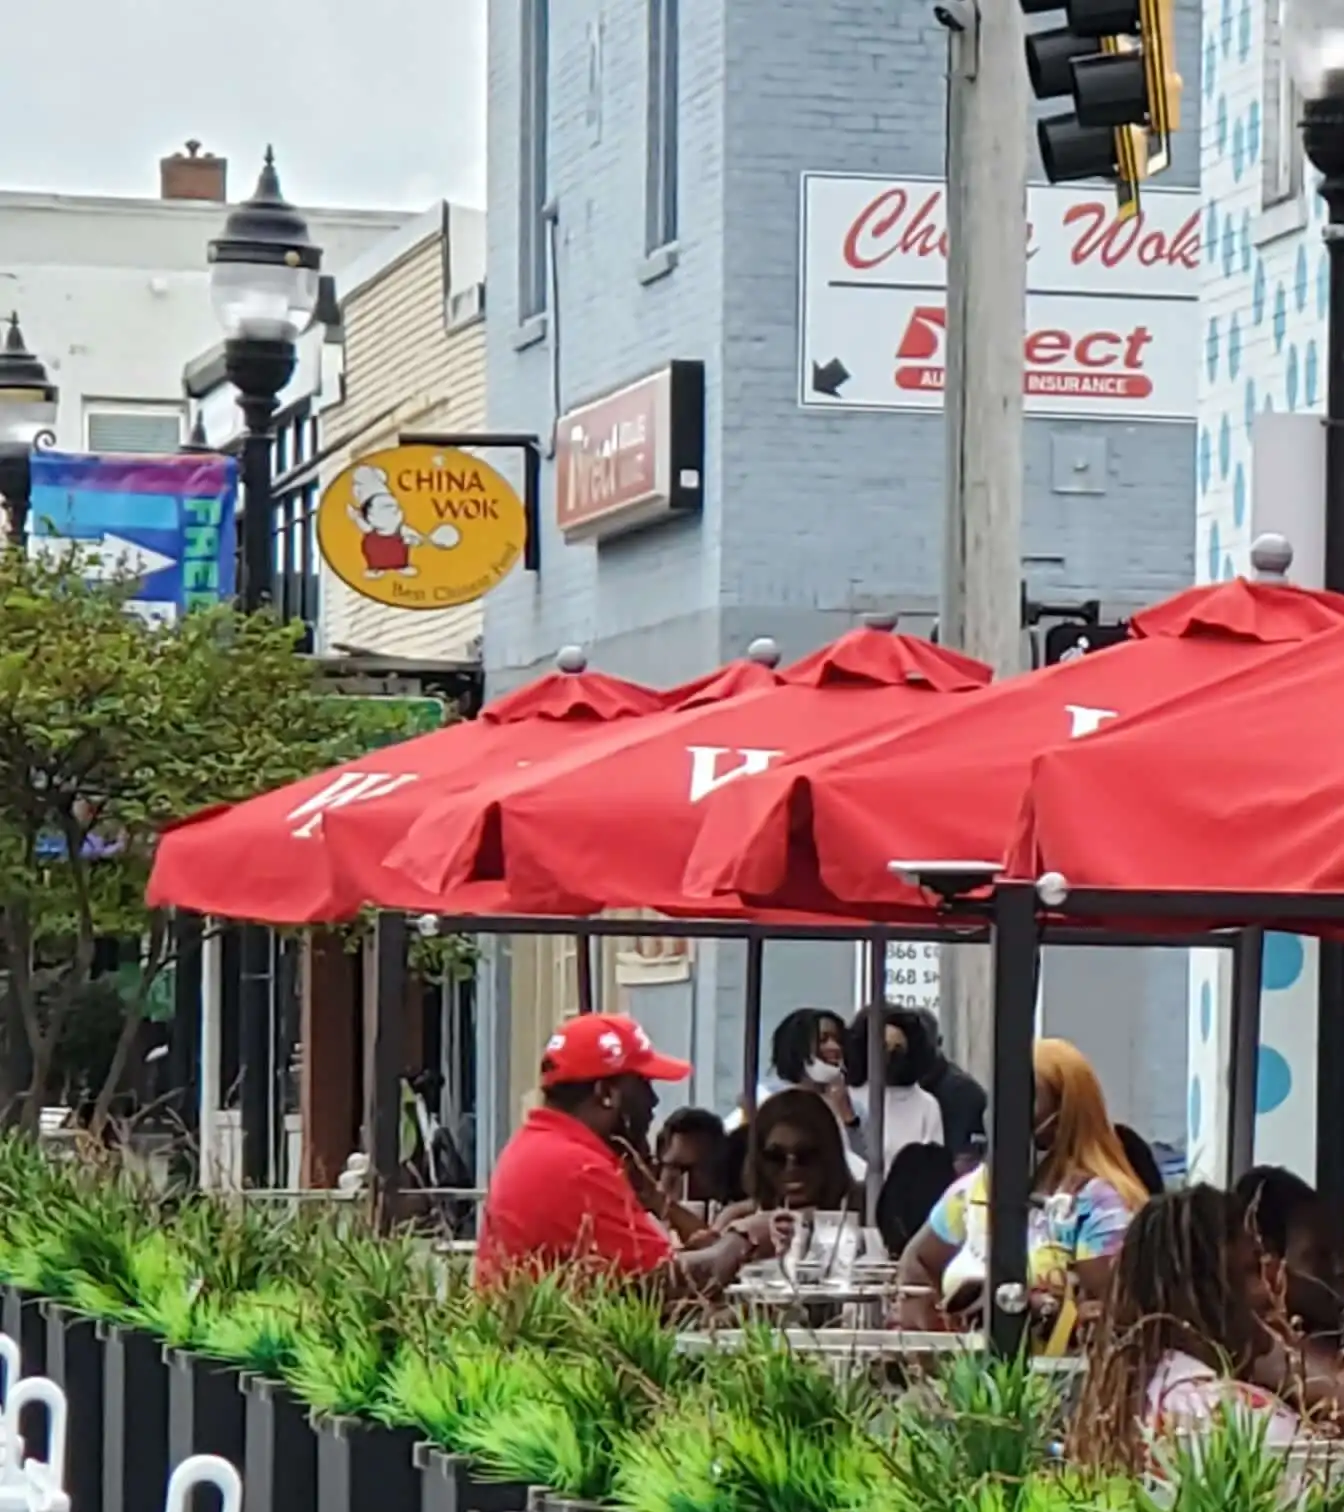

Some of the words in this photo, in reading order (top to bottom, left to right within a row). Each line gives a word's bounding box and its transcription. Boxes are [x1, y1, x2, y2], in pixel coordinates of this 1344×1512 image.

[1063, 202, 1201, 269] Wok
[896, 307, 1153, 369] Dect
[1028, 374, 1129, 395] INSURANCE
[398, 469, 486, 493] CHINA
[431, 497, 500, 521] WOK
